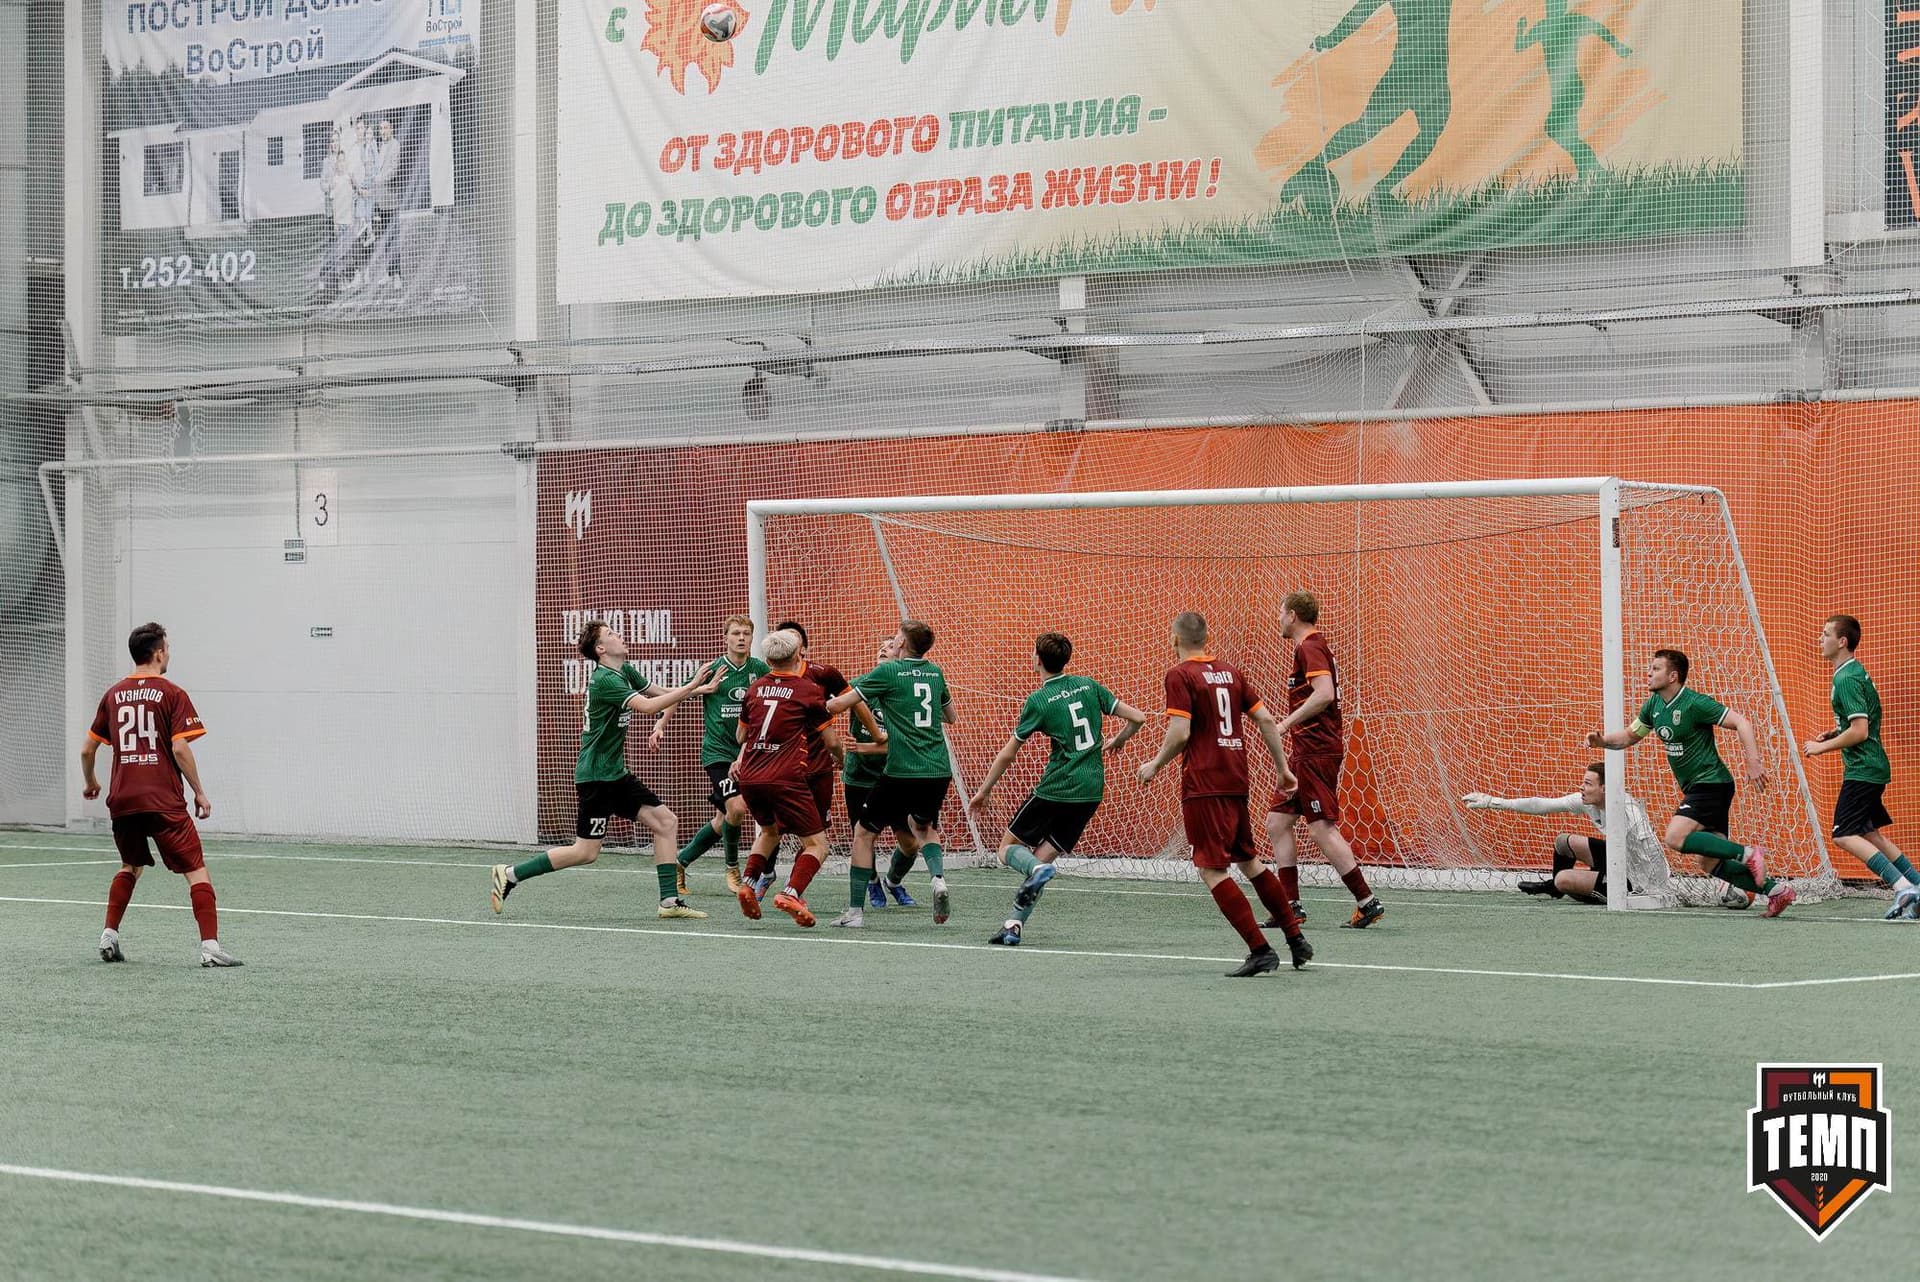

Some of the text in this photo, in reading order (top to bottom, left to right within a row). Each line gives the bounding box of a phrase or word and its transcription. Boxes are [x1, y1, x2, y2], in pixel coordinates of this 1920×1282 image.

[187, 28, 323, 74] ВоСтрой
[659, 134, 709, 173] ОТ
[714, 114, 939, 176] ЗДОРОВОГО
[949, 95, 1141, 150] ПИТАНИЯ
[599, 202, 651, 245] ДО
[657, 186, 877, 242] ЗДОРОВОГО
[886, 172, 1033, 221] ОБРАЗА
[120, 250, 256, 290] т.252-402
[315, 493, 328, 526] 3
[629, 610, 676, 648] ТЕМП,
[115, 687, 163, 704] КУЗНЕЦОВ
[756, 686, 793, 699] ЖДАНОВ
[914, 683, 932, 727] 3
[1216, 688, 1233, 736] 9
[118, 704, 158, 752] 24
[759, 700, 778, 740] 7
[1068, 701, 1095, 751] 5
[120, 754, 158, 764] SEUS
[1217, 738, 1243, 747] SEUS
[719, 778, 736, 797] 22
[590, 817, 606, 836] 23
